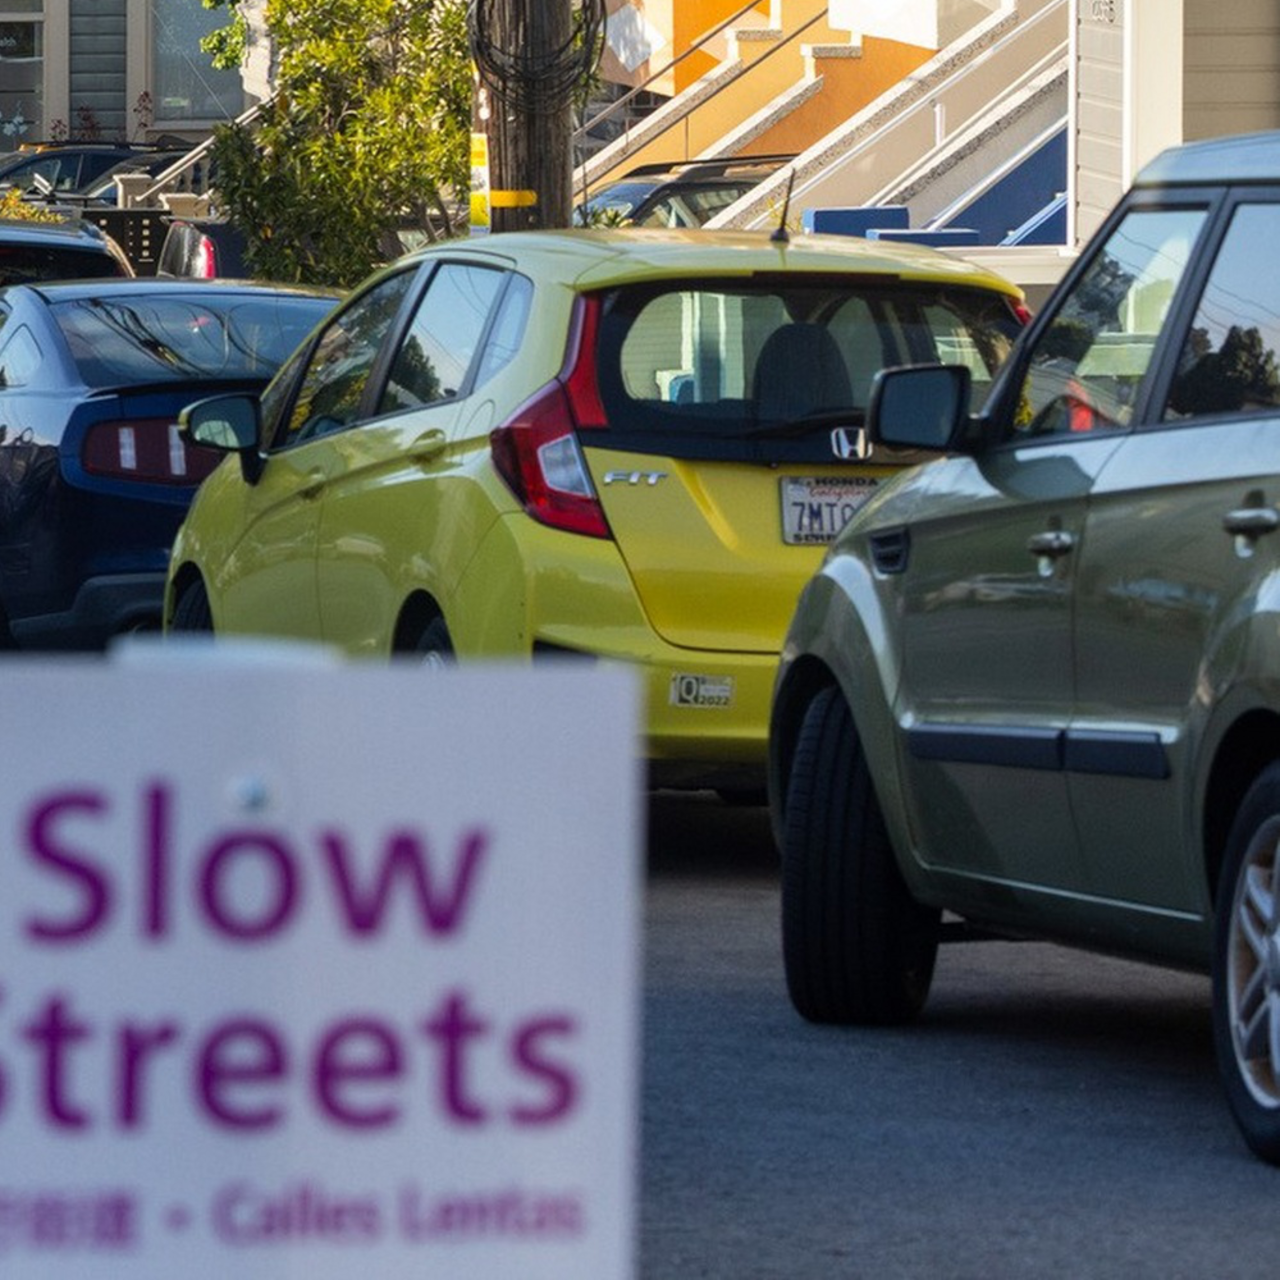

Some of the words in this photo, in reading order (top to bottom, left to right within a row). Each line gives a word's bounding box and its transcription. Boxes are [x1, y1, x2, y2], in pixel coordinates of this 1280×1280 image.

[603, 471, 668, 485] FIT
[814, 478, 878, 487] HONDA
[19, 777, 489, 948] Slow
[210, 1180, 381, 1247] Calles
[400, 1188, 582, 1241] Lentas
